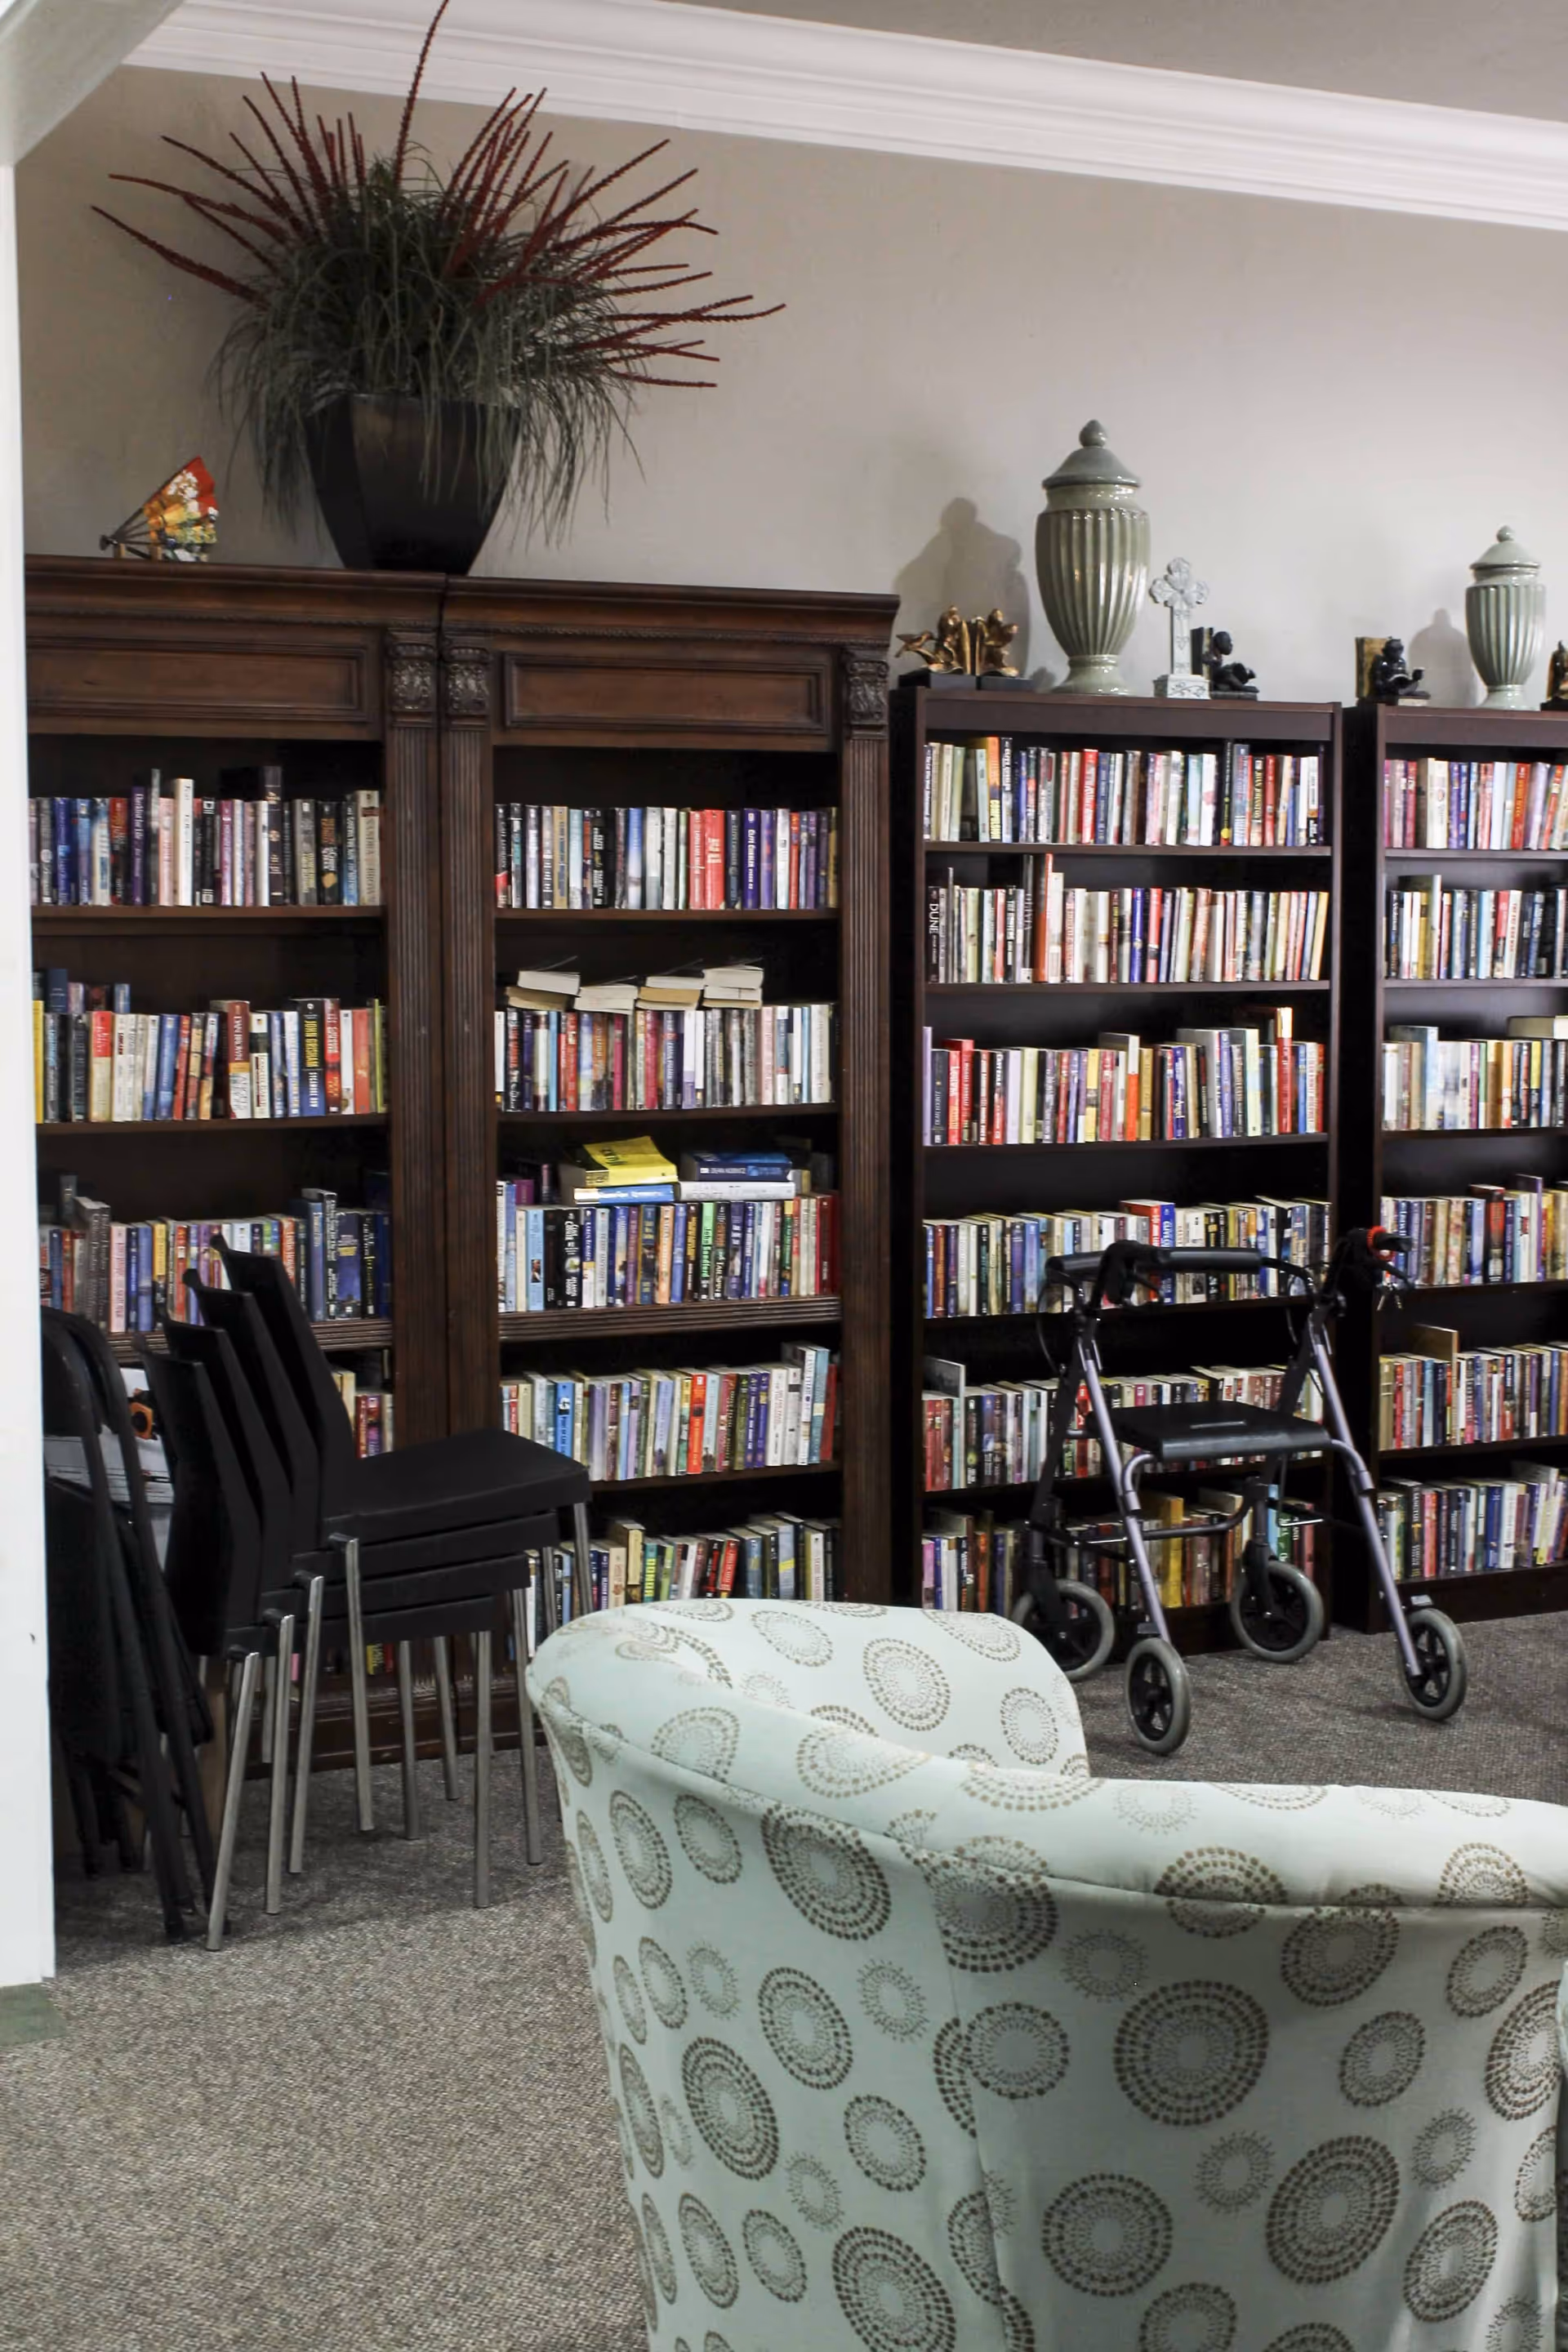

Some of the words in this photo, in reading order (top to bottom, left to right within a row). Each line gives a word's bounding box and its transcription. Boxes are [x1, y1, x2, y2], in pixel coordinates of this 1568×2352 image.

[1254, 770, 1263, 787] JOAN
[1252, 787, 1263, 819] JOHNSTON
[989, 800, 1001, 840] COMPULSION
[133, 829, 144, 840] Life
[365, 817, 376, 856] SANDRA
[747, 829, 756, 844] CLIVE
[746, 844, 756, 868] CUSSLER
[364, 868, 376, 903] BROWN
[929, 903, 940, 934] DUNE
[1023, 893, 1033, 930] OLIVIA
[234, 1016, 244, 1034] DAN
[305, 1020, 318, 1037] JOHN
[234, 1034, 244, 1061] BROWN
[305, 1038, 319, 1067] GRISHAM
[308, 1071, 318, 1097] SYCAMORE
[308, 1098, 318, 1108] ROW
[1174, 1099, 1186, 1119] Angel
[585, 1222, 593, 1239] KAREN
[702, 1227, 714, 1245] John
[701, 1245, 713, 1277] Sandford
